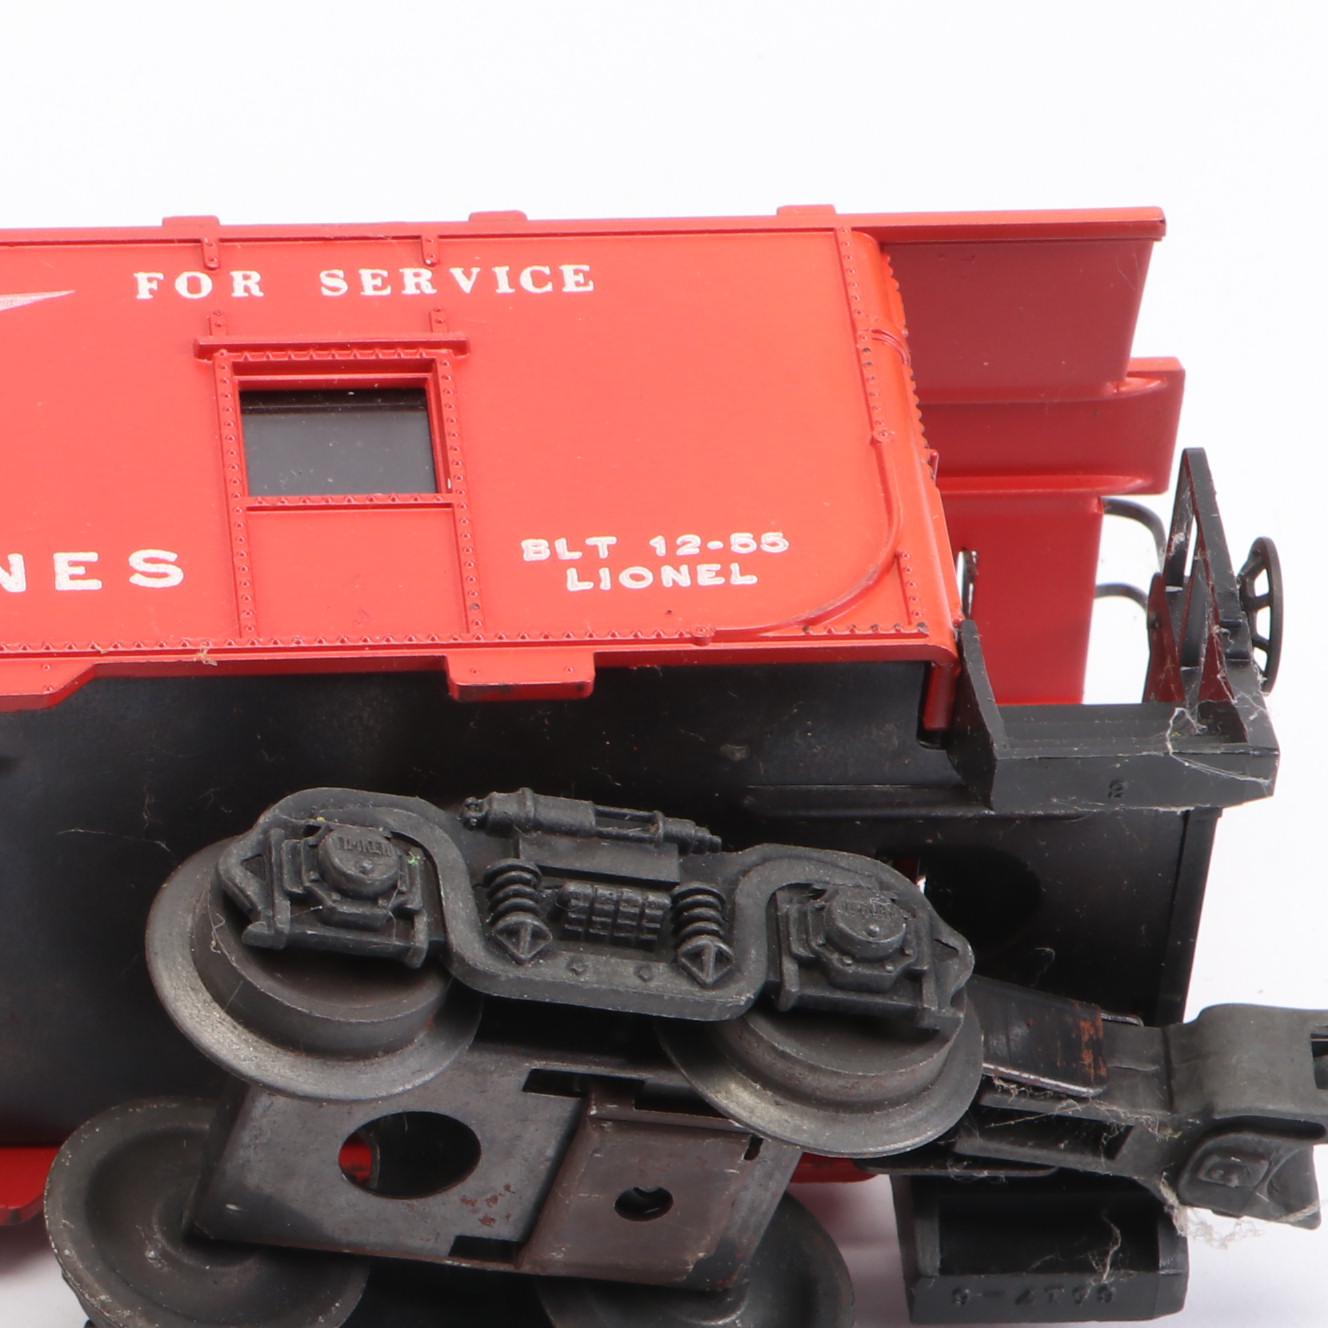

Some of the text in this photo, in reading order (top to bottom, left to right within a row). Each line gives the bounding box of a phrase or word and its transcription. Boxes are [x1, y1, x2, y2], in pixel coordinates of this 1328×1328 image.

[133, 264, 595, 300] FOR SERVICE
[520, 531, 790, 562] BLT 12-55
[566, 562, 758, 592] LIONEL
